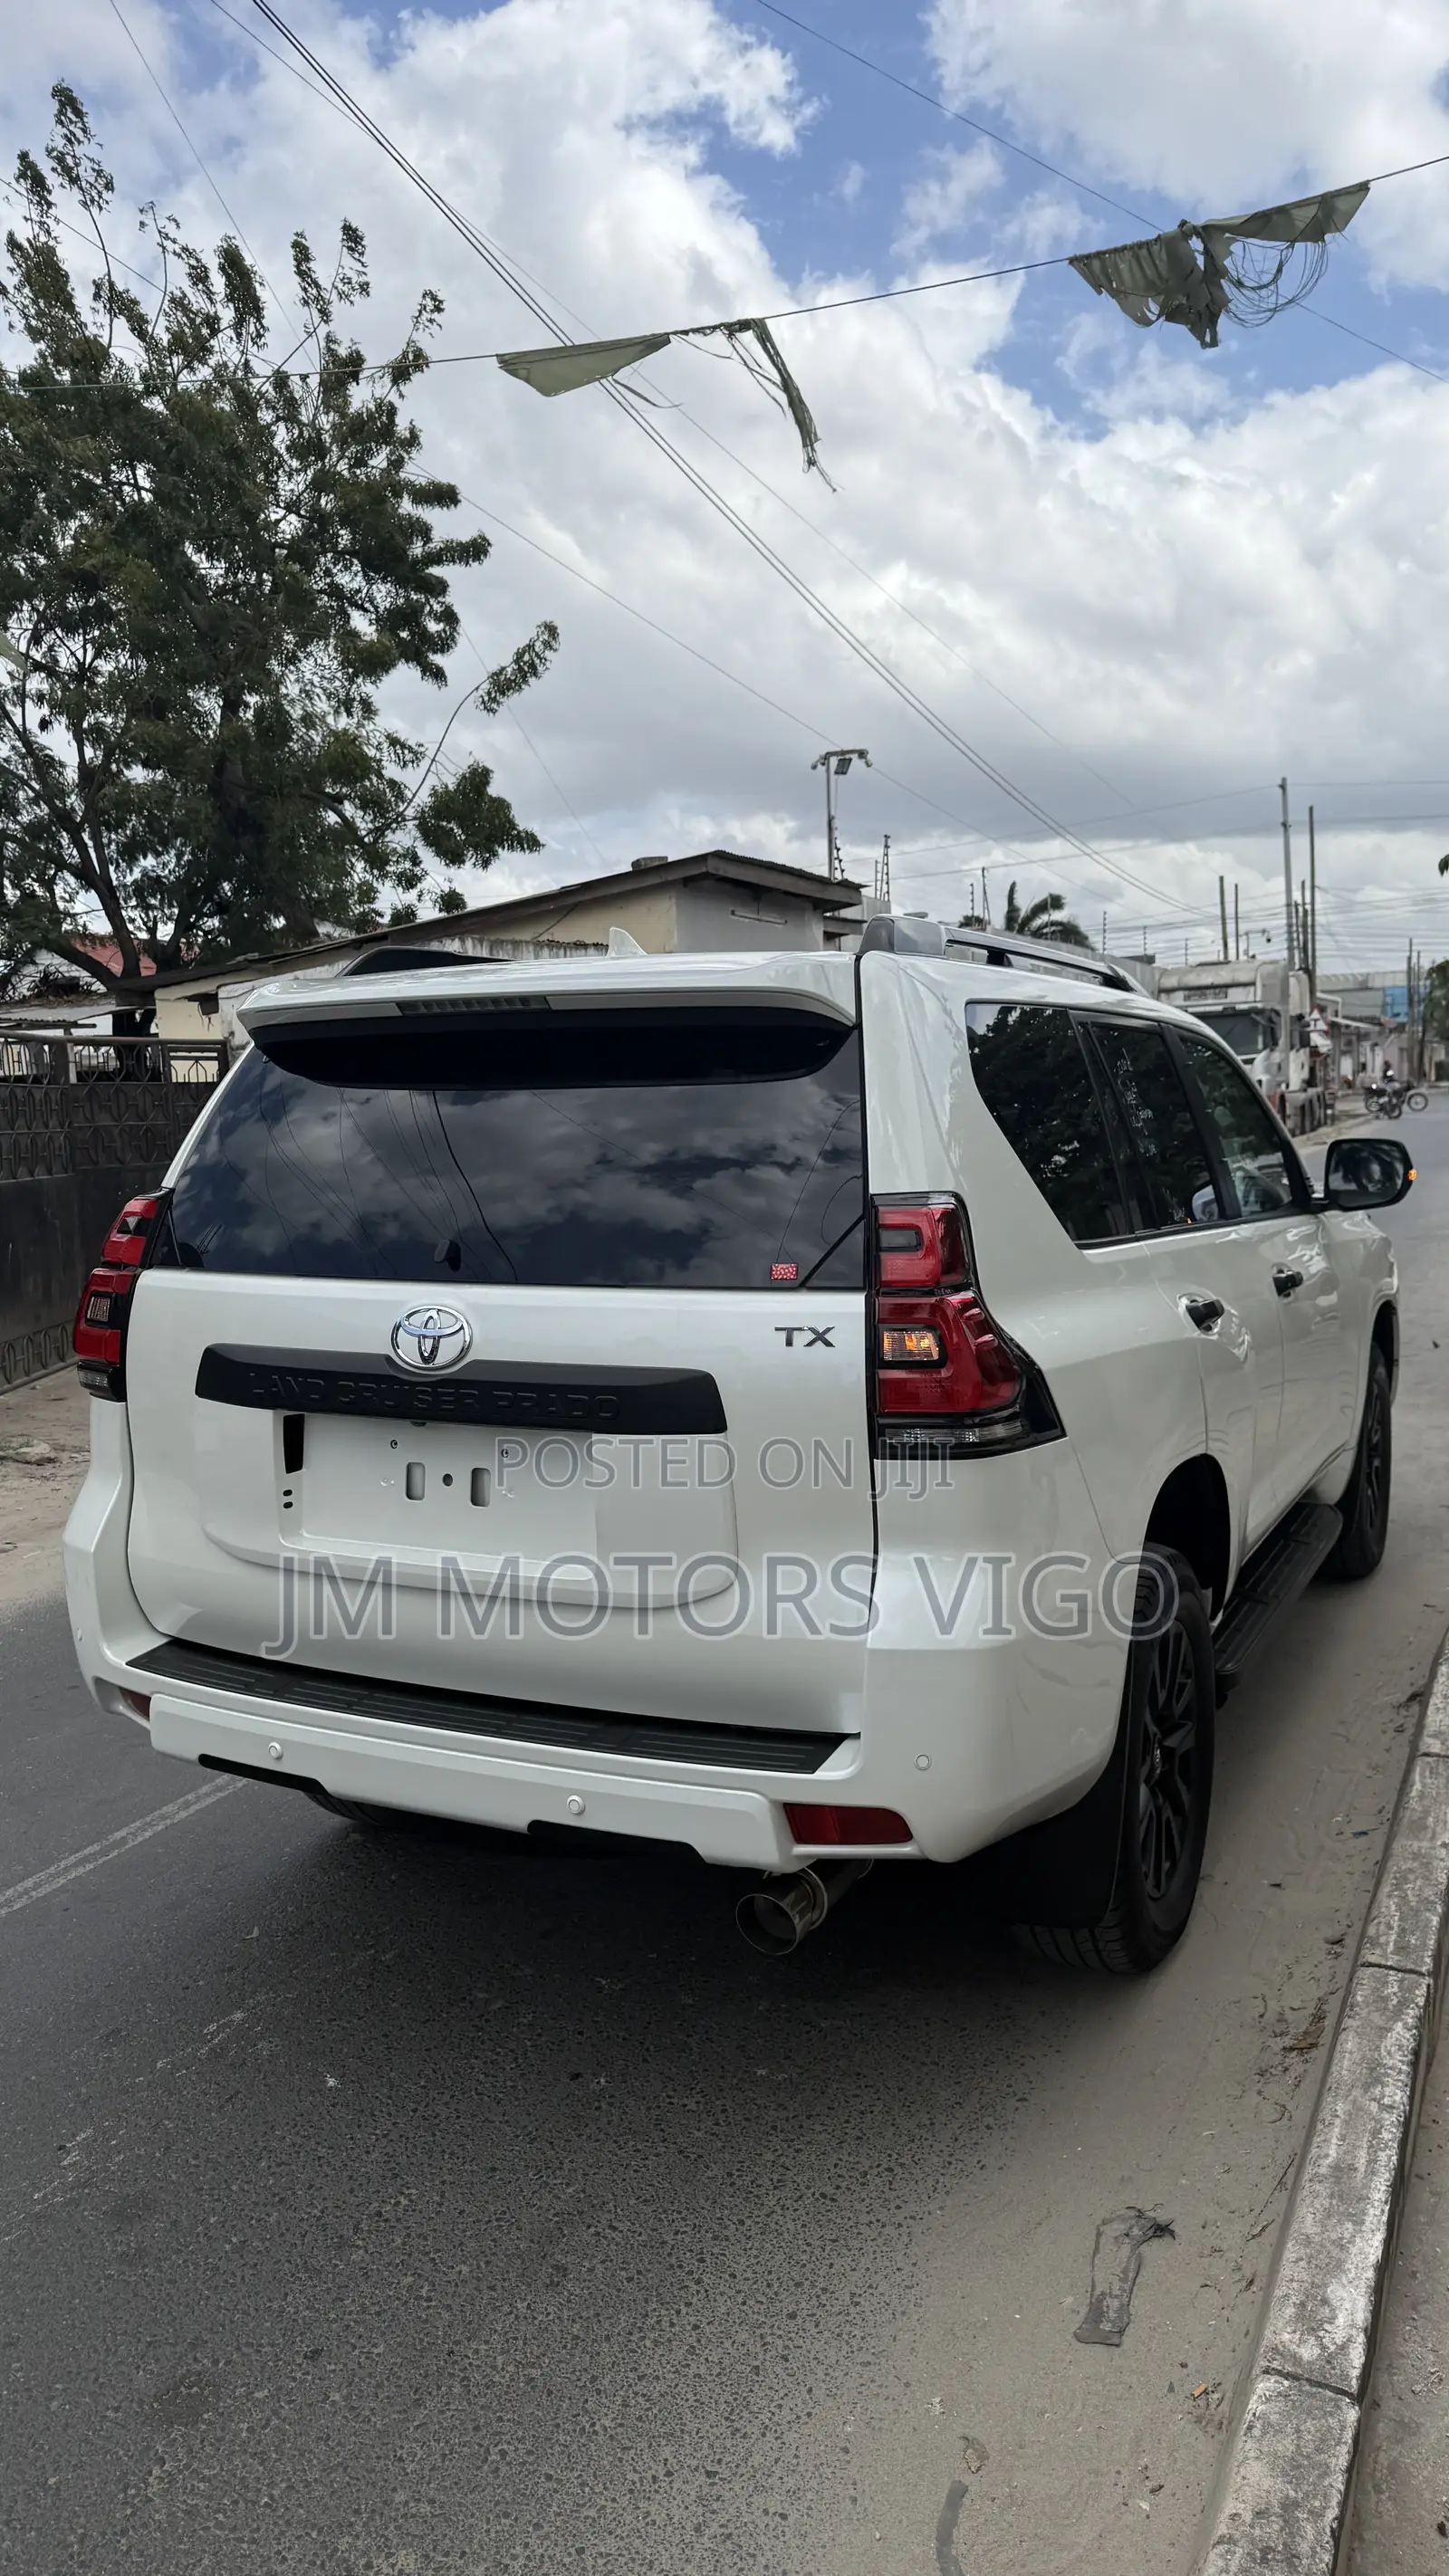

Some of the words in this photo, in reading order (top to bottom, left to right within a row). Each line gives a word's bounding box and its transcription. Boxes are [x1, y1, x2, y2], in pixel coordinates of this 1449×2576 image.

[774, 1326, 835, 1347] TX
[249, 1372, 325, 1400] LAND
[337, 1380, 481, 1410] CRUISER
[492, 1390, 620, 1420] PRADO
